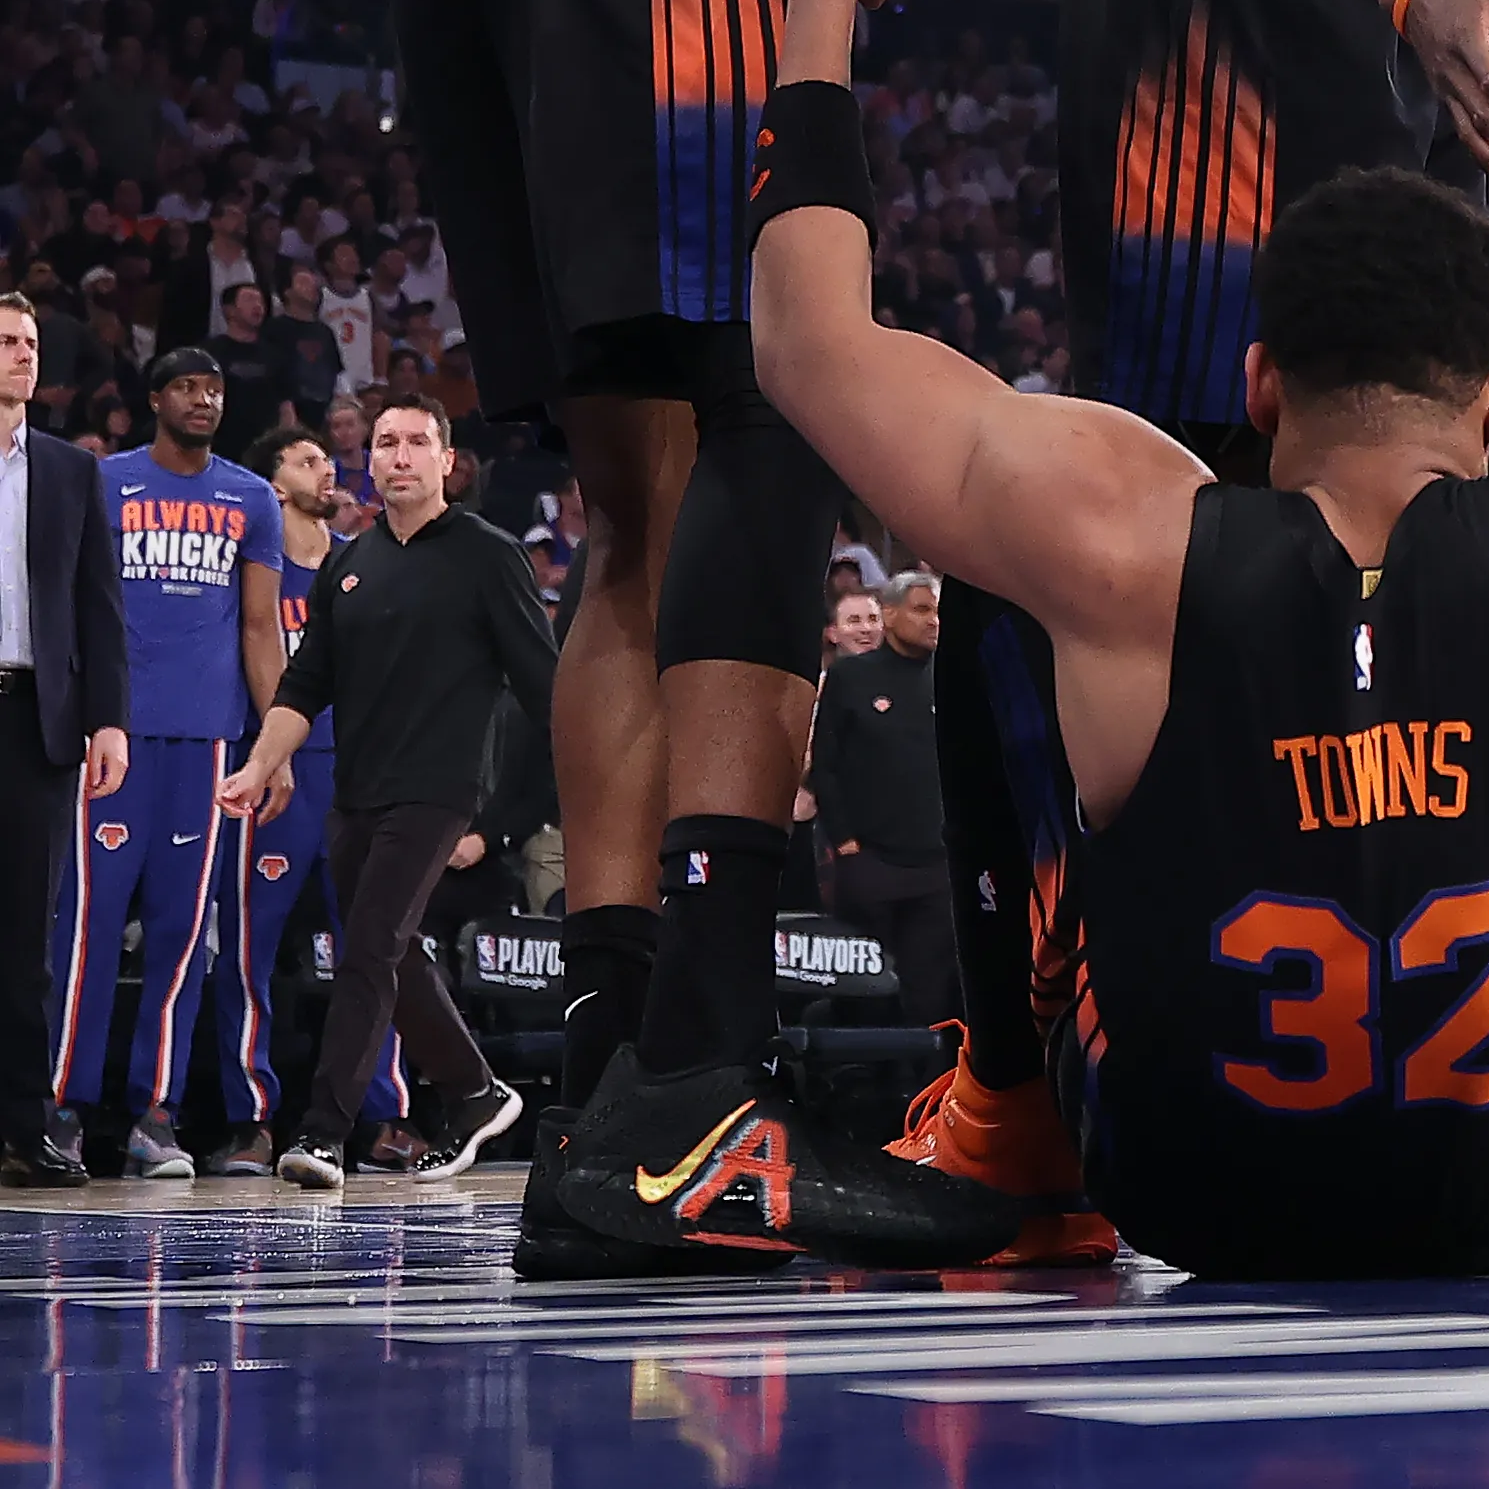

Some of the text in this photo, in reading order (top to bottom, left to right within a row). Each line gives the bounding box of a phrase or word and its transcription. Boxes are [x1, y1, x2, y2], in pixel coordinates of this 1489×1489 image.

[121, 499, 247, 541] ALWAYS
[122, 530, 238, 573] KNICKS
[1272, 720, 1472, 832] TOWNS
[498, 937, 565, 977] PLAYO
[788, 934, 882, 974] PLAYOFFS
